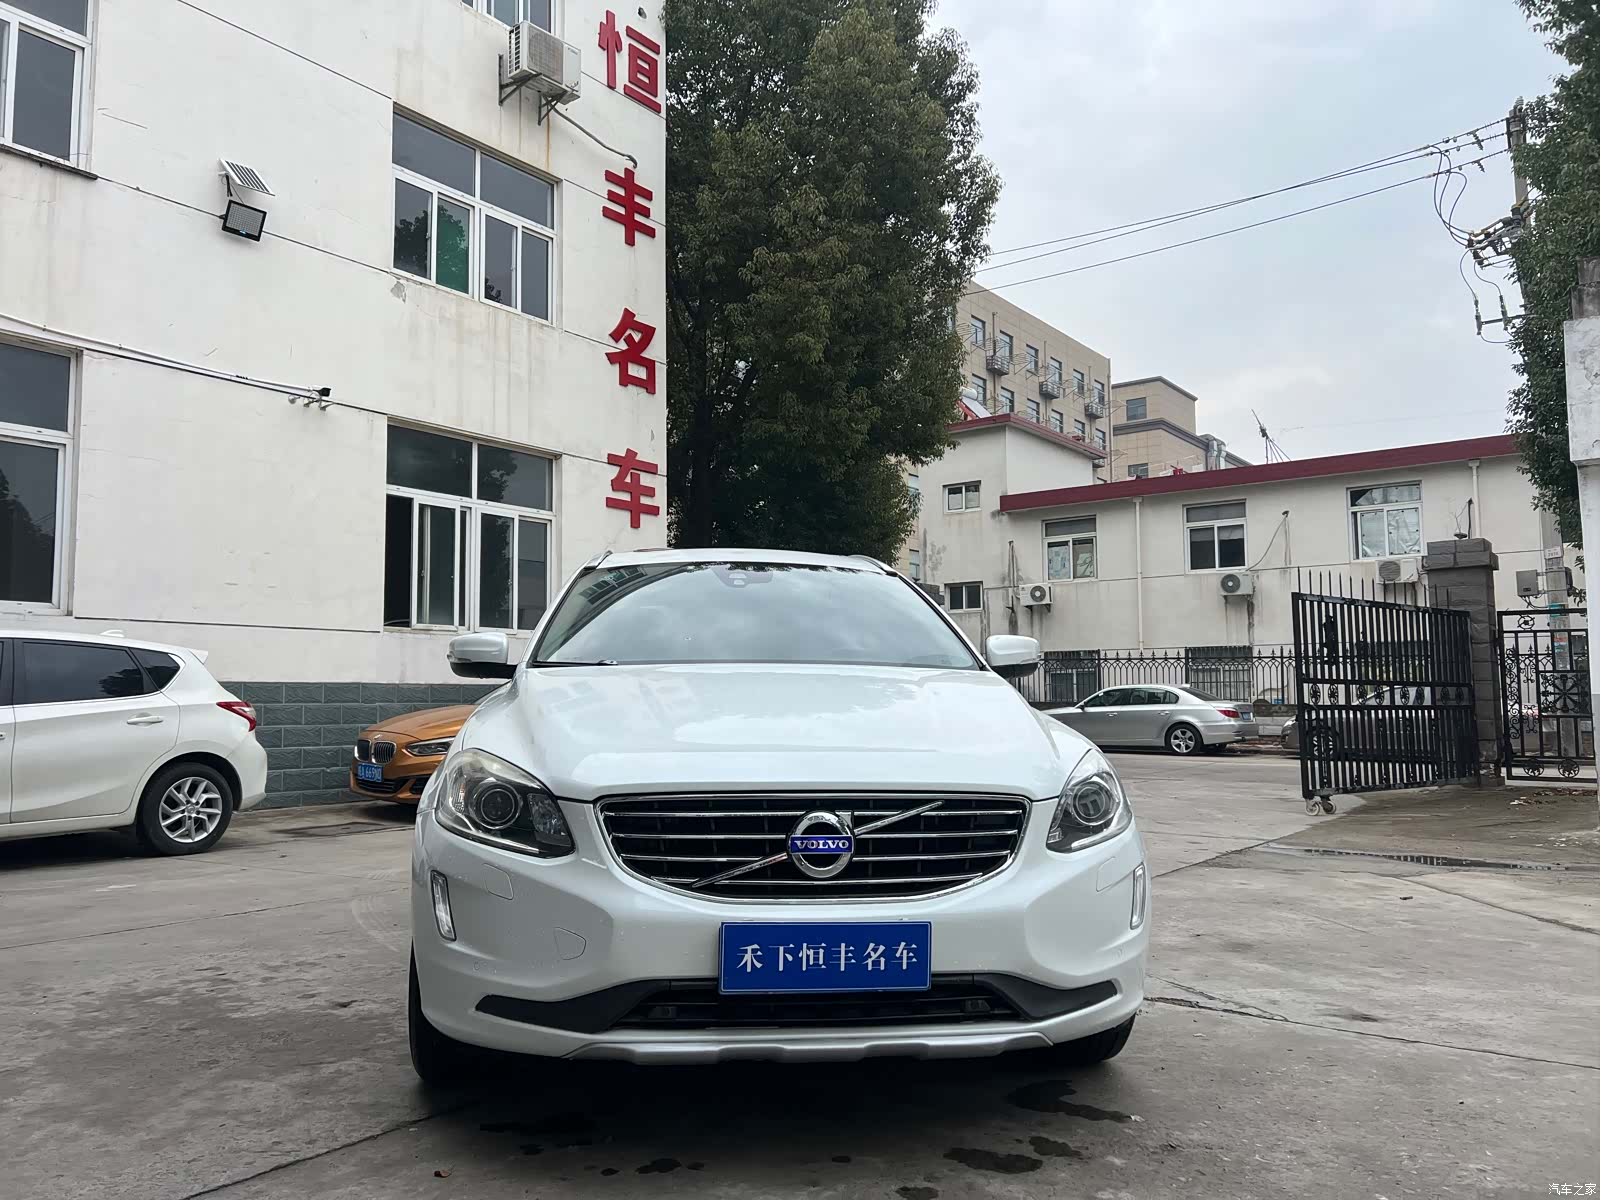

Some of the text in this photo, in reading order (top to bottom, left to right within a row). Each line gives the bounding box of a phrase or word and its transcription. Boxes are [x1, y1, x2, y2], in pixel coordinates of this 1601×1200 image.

[598, 10, 662, 529] 恒丰名车
[794, 839, 849, 849] VOLVO
[736, 941, 918, 973] 禾下恒丰名车
